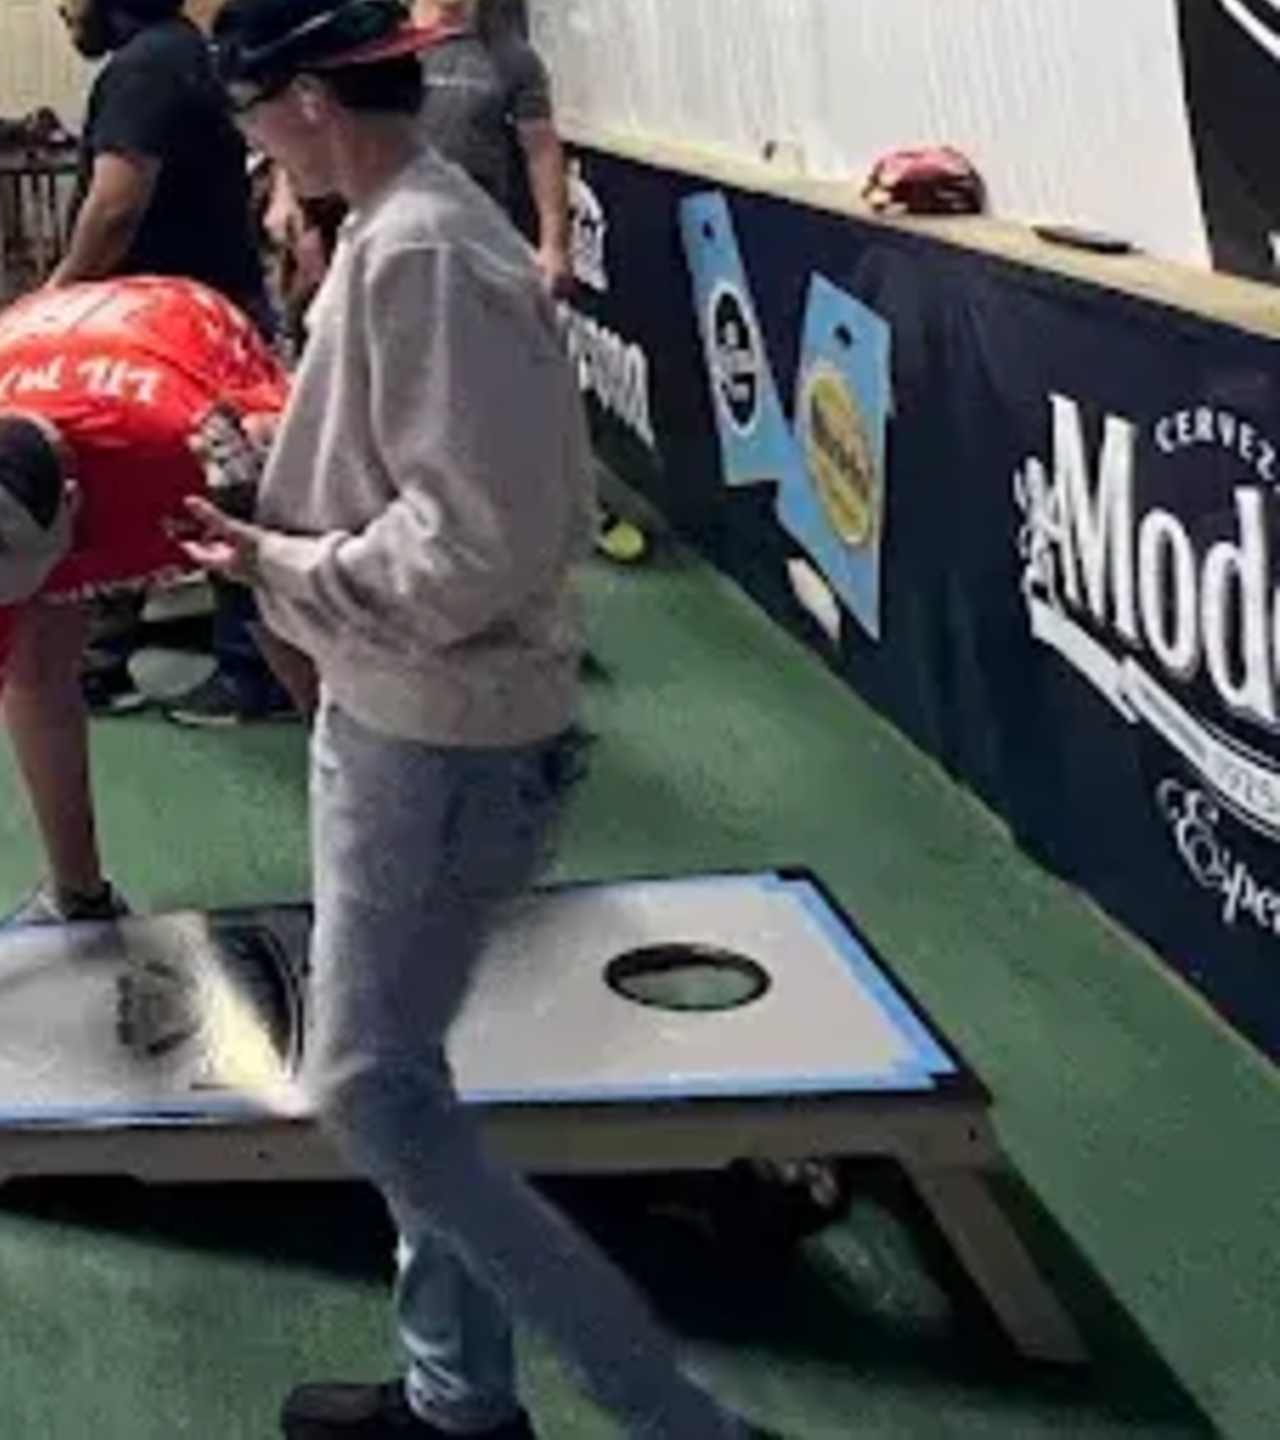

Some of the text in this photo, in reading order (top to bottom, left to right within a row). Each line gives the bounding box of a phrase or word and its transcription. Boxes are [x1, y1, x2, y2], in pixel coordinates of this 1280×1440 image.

[1154, 406, 1280, 495] CERVEZ
[1046, 392, 1280, 732] Mod
[1155, 778, 1280, 935] Espe
